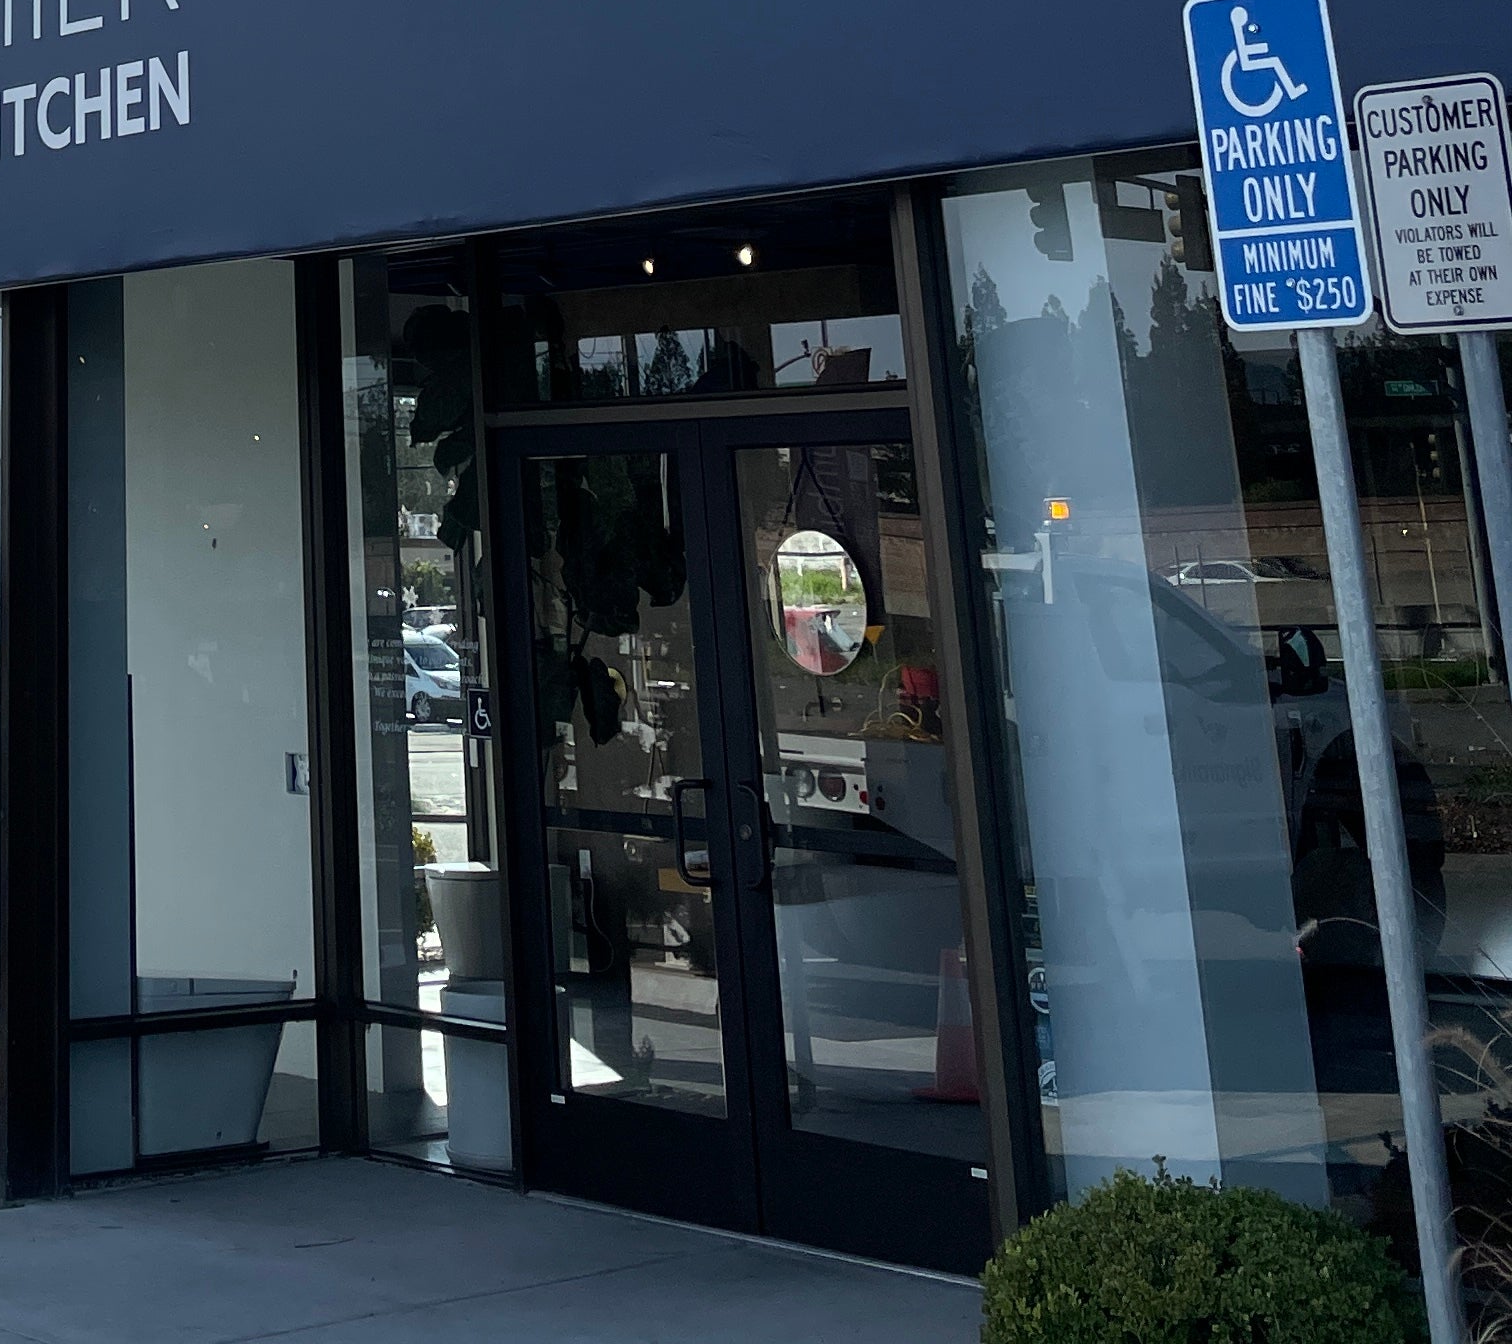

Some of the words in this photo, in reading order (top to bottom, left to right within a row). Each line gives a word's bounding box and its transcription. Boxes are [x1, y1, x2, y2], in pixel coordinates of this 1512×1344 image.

[1367, 98, 1494, 139] CUSTOMER
[1211, 115, 1338, 172] PARKING
[1384, 141, 1488, 179] PARKING
[1243, 172, 1316, 223] ONLY
[1410, 184, 1470, 219] ONLY
[1395, 224, 1463, 244] VIOLATORS
[1467, 221, 1499, 238] WILL
[1242, 237, 1336, 274] MINIMUM
[1416, 248, 1435, 264] BE
[1438, 244, 1481, 262] TOWED
[1409, 269, 1425, 286] AT
[1427, 267, 1464, 285] THEIR
[1469, 265, 1498, 282] OWN
[1233, 282, 1280, 315] FINE
[1295, 275, 1357, 314] $250
[1426, 287, 1485, 306] EXPENSE
